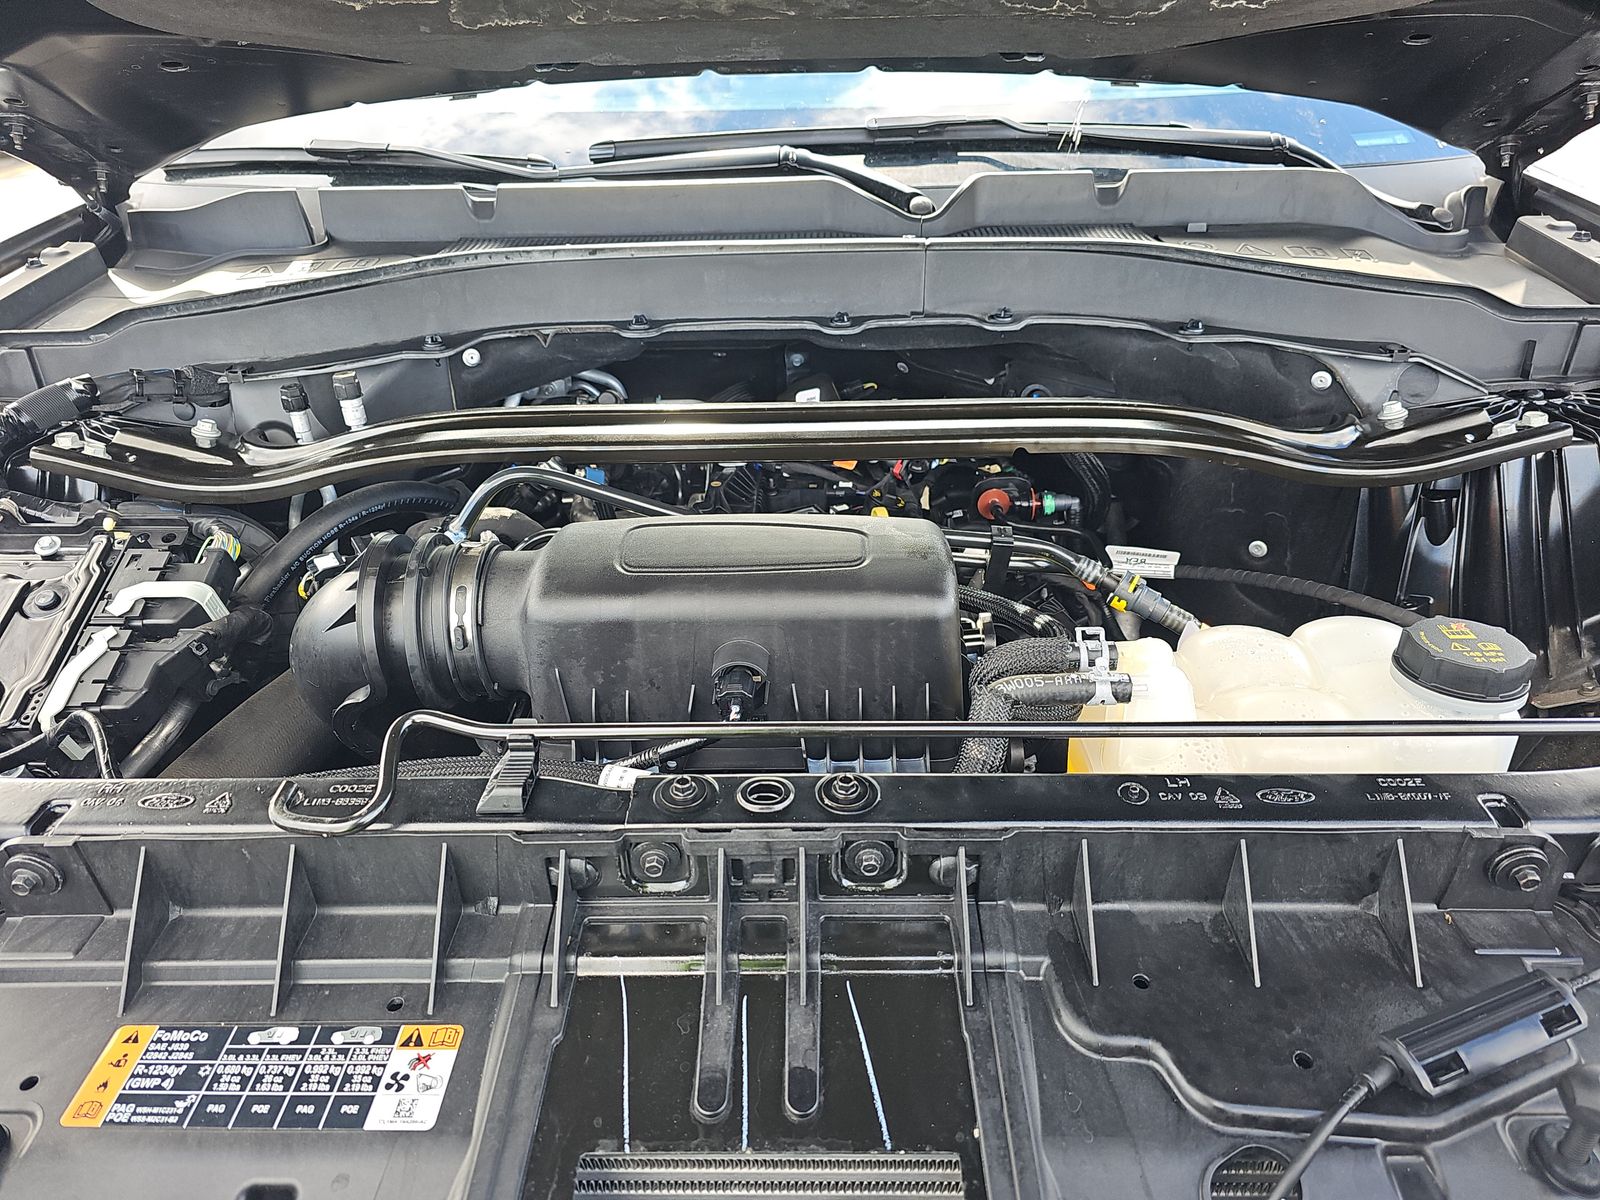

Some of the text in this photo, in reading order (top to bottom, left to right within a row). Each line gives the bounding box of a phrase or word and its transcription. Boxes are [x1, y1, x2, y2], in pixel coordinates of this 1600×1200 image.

[1164, 777, 1191, 788] LH
[97, 783, 127, 794] RH
[1158, 792, 1182, 801] CAV
[81, 797, 106, 807] CAV
[153, 1030, 209, 1042] FoMoCo
[148, 1043, 190, 1051] SAE J639
[133, 1065, 187, 1077] R-1234yf
[216, 1065, 254, 1077] 0.680 kg
[259, 1065, 296, 1077] 0.737 kg
[304, 1065, 342, 1077] 0.992 kg
[347, 1065, 384, 1077] 0.992 kg
[125, 1078, 175, 1090] (GWP 4)
[219, 1075, 241, 1083] 24 oz
[273, 1075, 284, 1083] oz
[308, 1075, 330, 1083] 35 oz
[351, 1075, 373, 1083] 35 oz
[229, 1083, 241, 1091] lbs
[255, 1083, 284, 1091] 1.63 lbs
[300, 1083, 330, 1091] 2.19 lbs
[360, 1083, 373, 1091] lbs
[111, 1104, 136, 1113] PAG
[206, 1104, 226, 1114] PAG
[250, 1104, 271, 1114] POE
[295, 1104, 316, 1114] PAG
[340, 1104, 360, 1114] POE
[106, 1113, 131, 1122] POE
